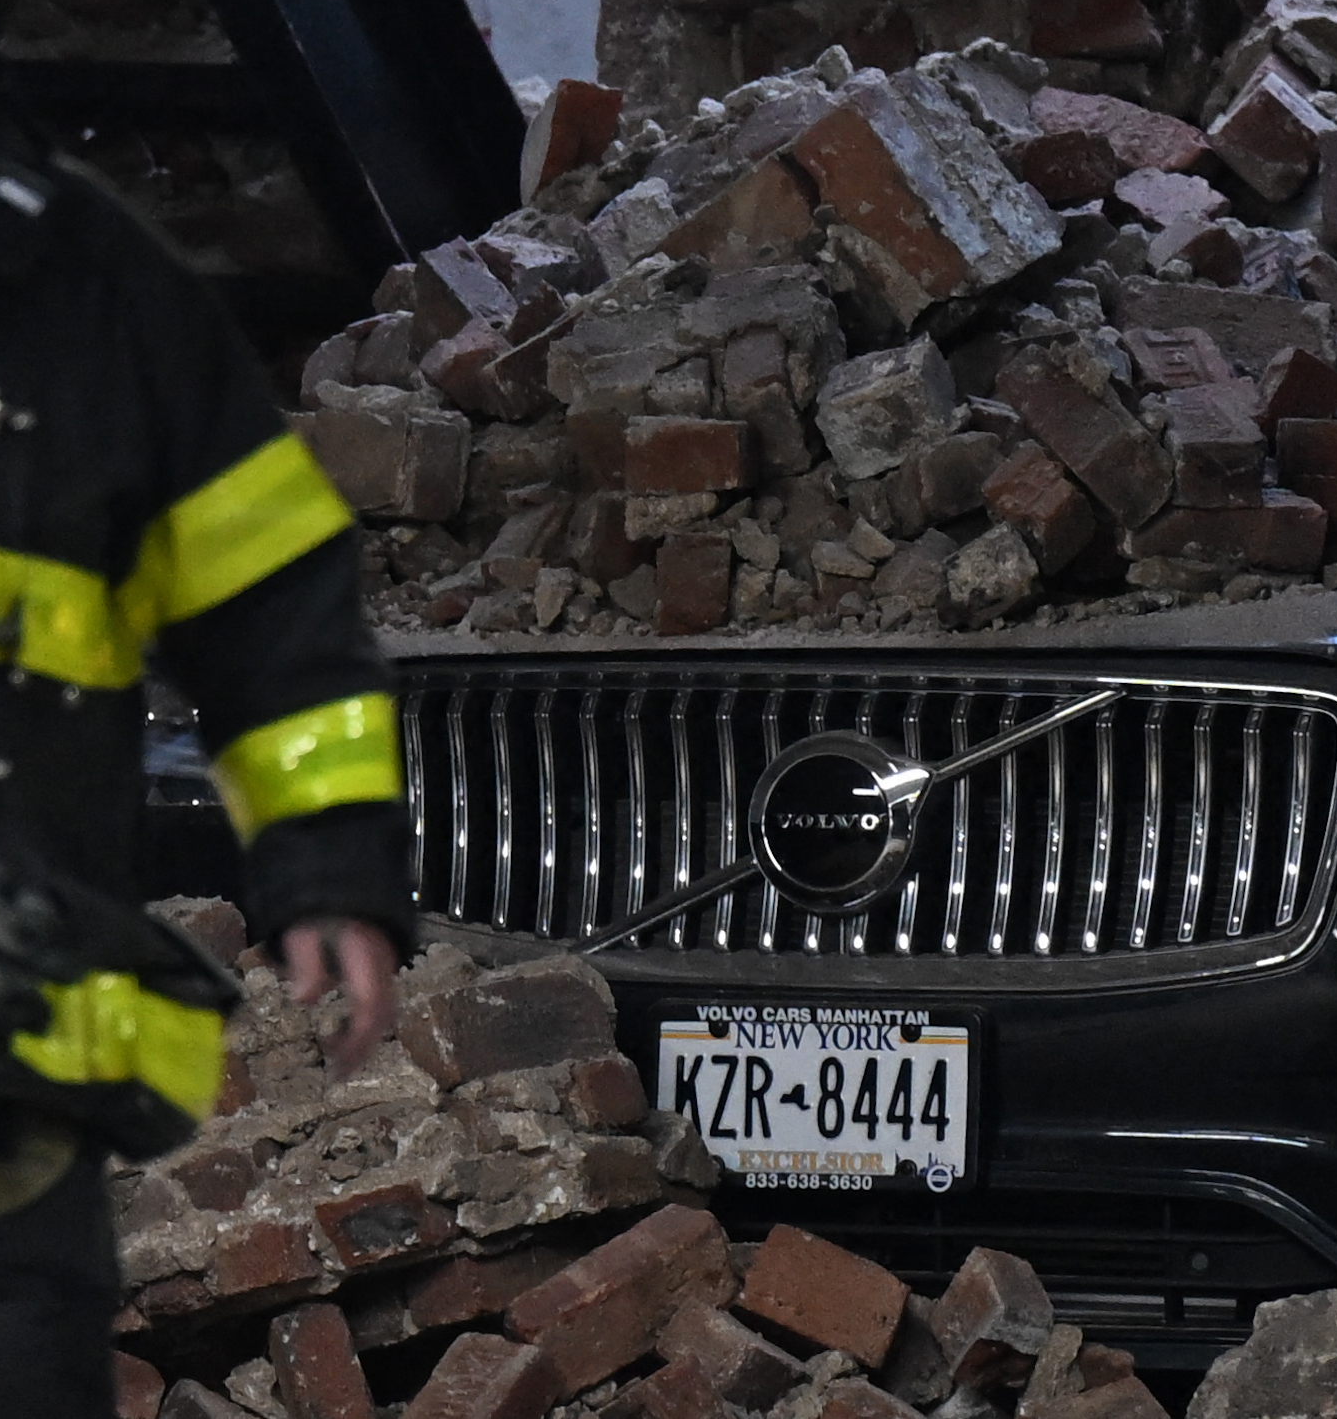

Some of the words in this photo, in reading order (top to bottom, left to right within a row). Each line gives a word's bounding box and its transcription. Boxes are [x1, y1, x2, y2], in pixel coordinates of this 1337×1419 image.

[776, 813, 880, 830] VOLVO
[697, 1006, 754, 1022] VOLVO
[762, 1007, 812, 1023] CARS
[816, 1008, 929, 1026] MANHATTAN
[734, 1023, 807, 1050] NEW
[812, 1025, 897, 1051] YORK
[675, 1055, 773, 1139] KZR
[816, 1056, 950, 1142] 8444
[737, 1150, 885, 1173] EXCELSIOR
[745, 1173, 873, 1191] 833-638-3630
